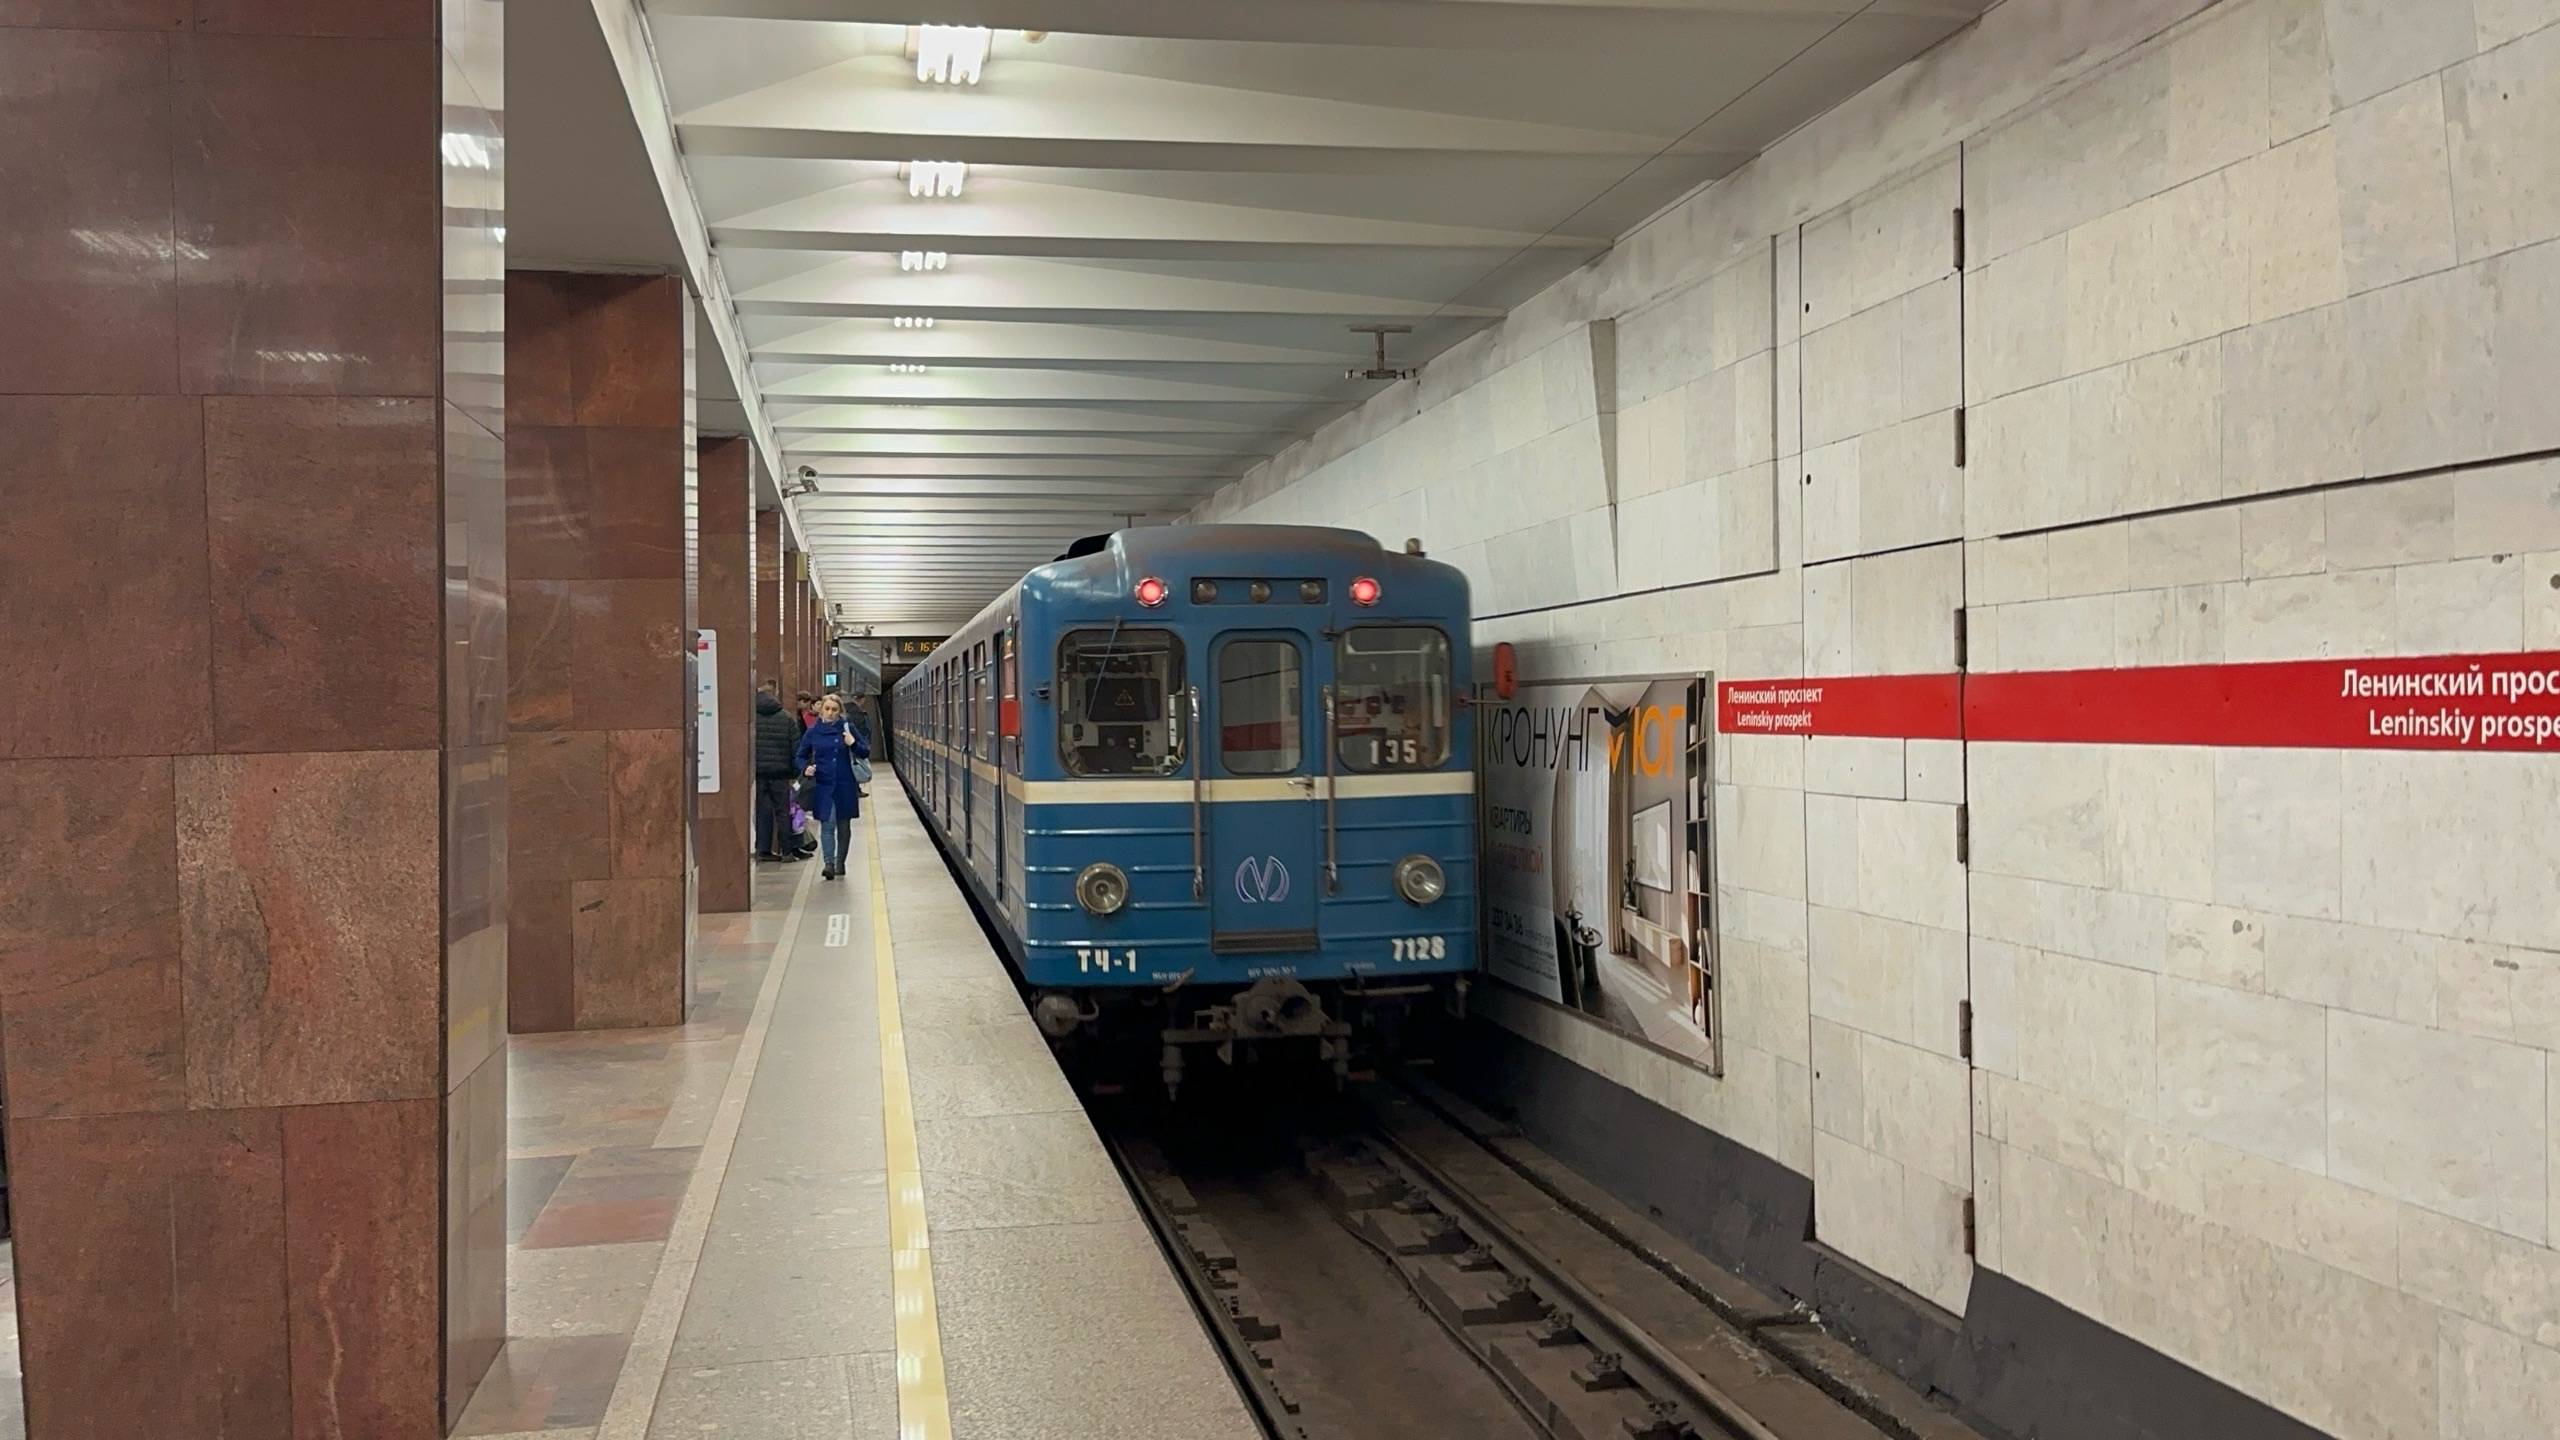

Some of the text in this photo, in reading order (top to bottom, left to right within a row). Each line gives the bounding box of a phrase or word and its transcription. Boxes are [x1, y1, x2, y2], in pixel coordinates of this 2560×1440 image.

[1728, 686, 1823, 707] Ленинский проспект
[2342, 664, 2560, 704] Ленинский прос
[1737, 710, 1812, 731] Leninskiy prospekt
[2370, 708, 2475, 745] Leninskiy
[1370, 739, 1416, 764] 135
[1488, 705, 1686, 780] КРОНУНГ ЮГ
[1077, 949, 1136, 973] ТЧ-1
[1391, 935, 1446, 962] 7128
